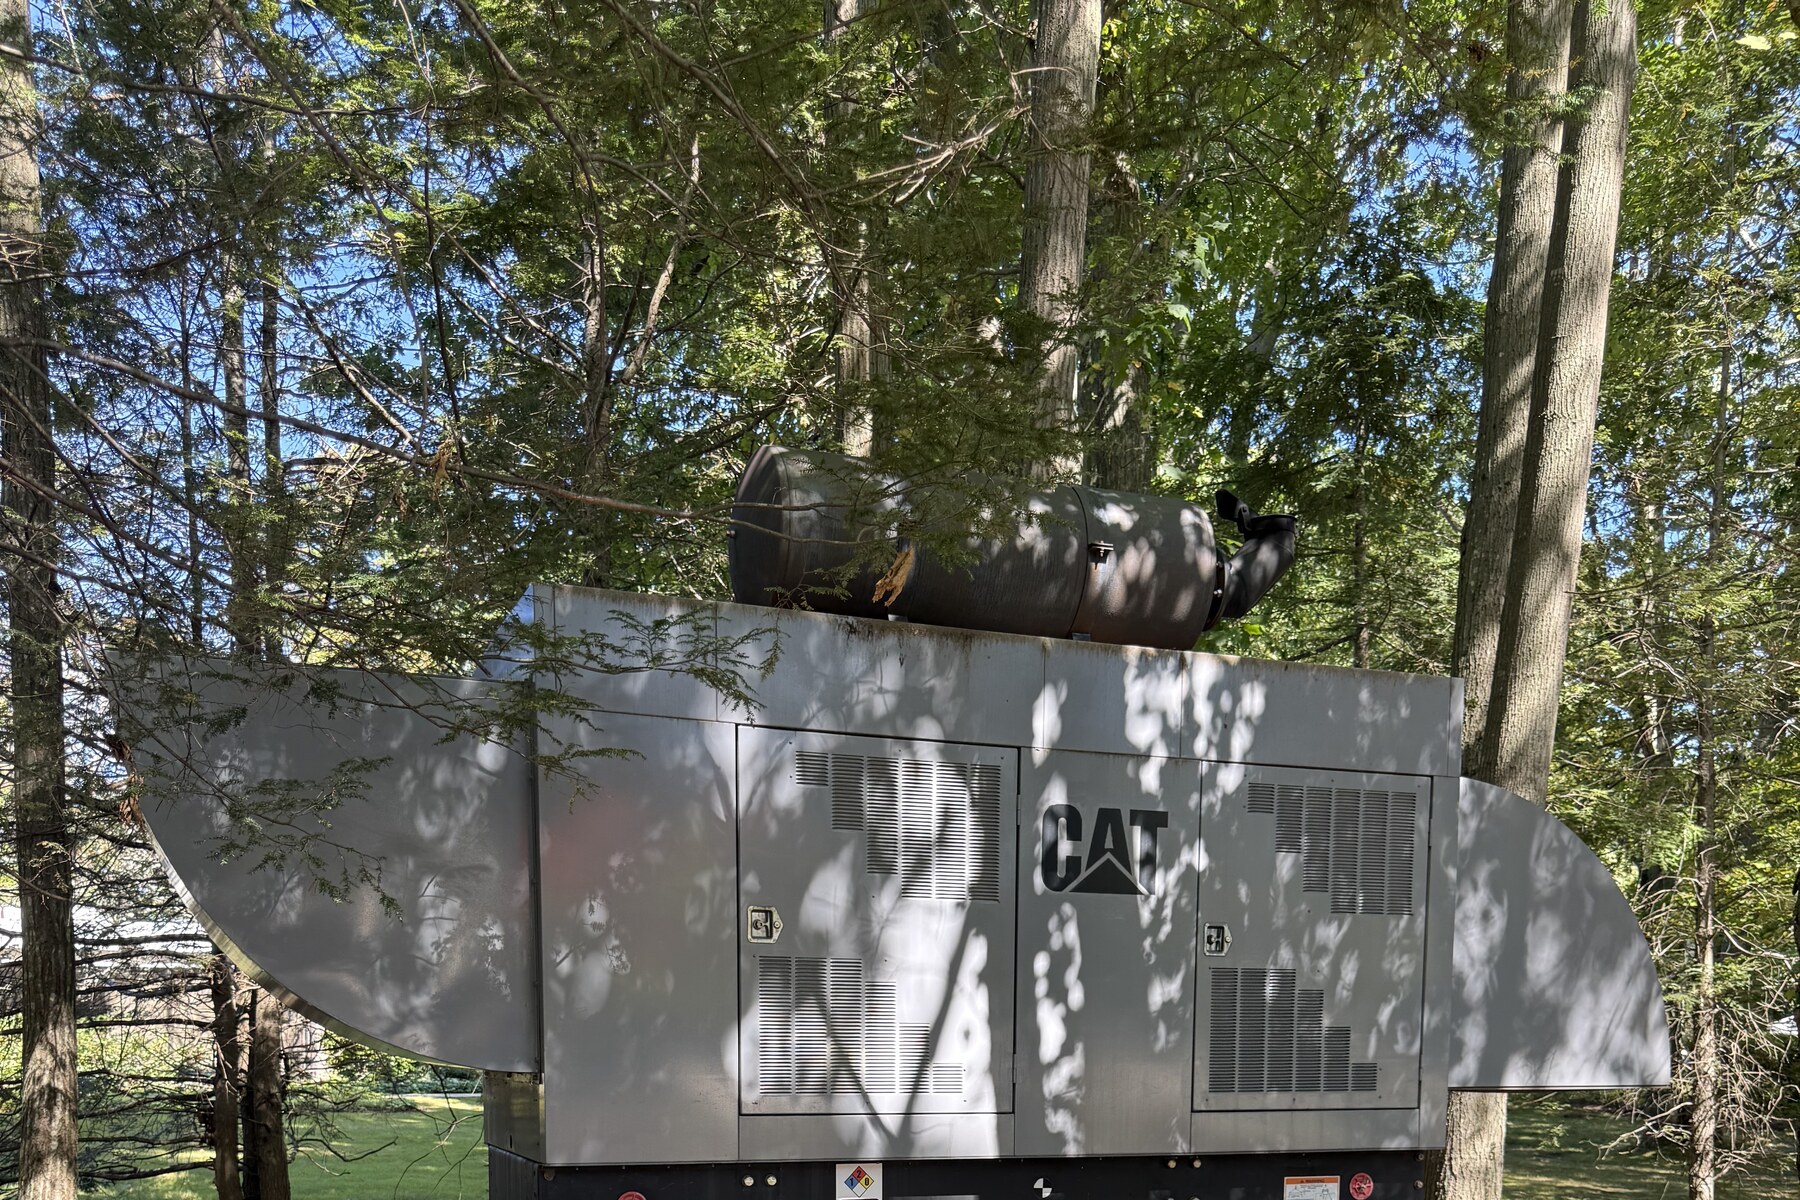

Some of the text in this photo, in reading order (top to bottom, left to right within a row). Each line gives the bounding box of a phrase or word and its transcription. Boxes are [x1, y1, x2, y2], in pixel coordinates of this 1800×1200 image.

[1041, 803, 1169, 896] CAT
[857, 1170, 862, 1178] 2
[865, 1177, 870, 1186] 0
